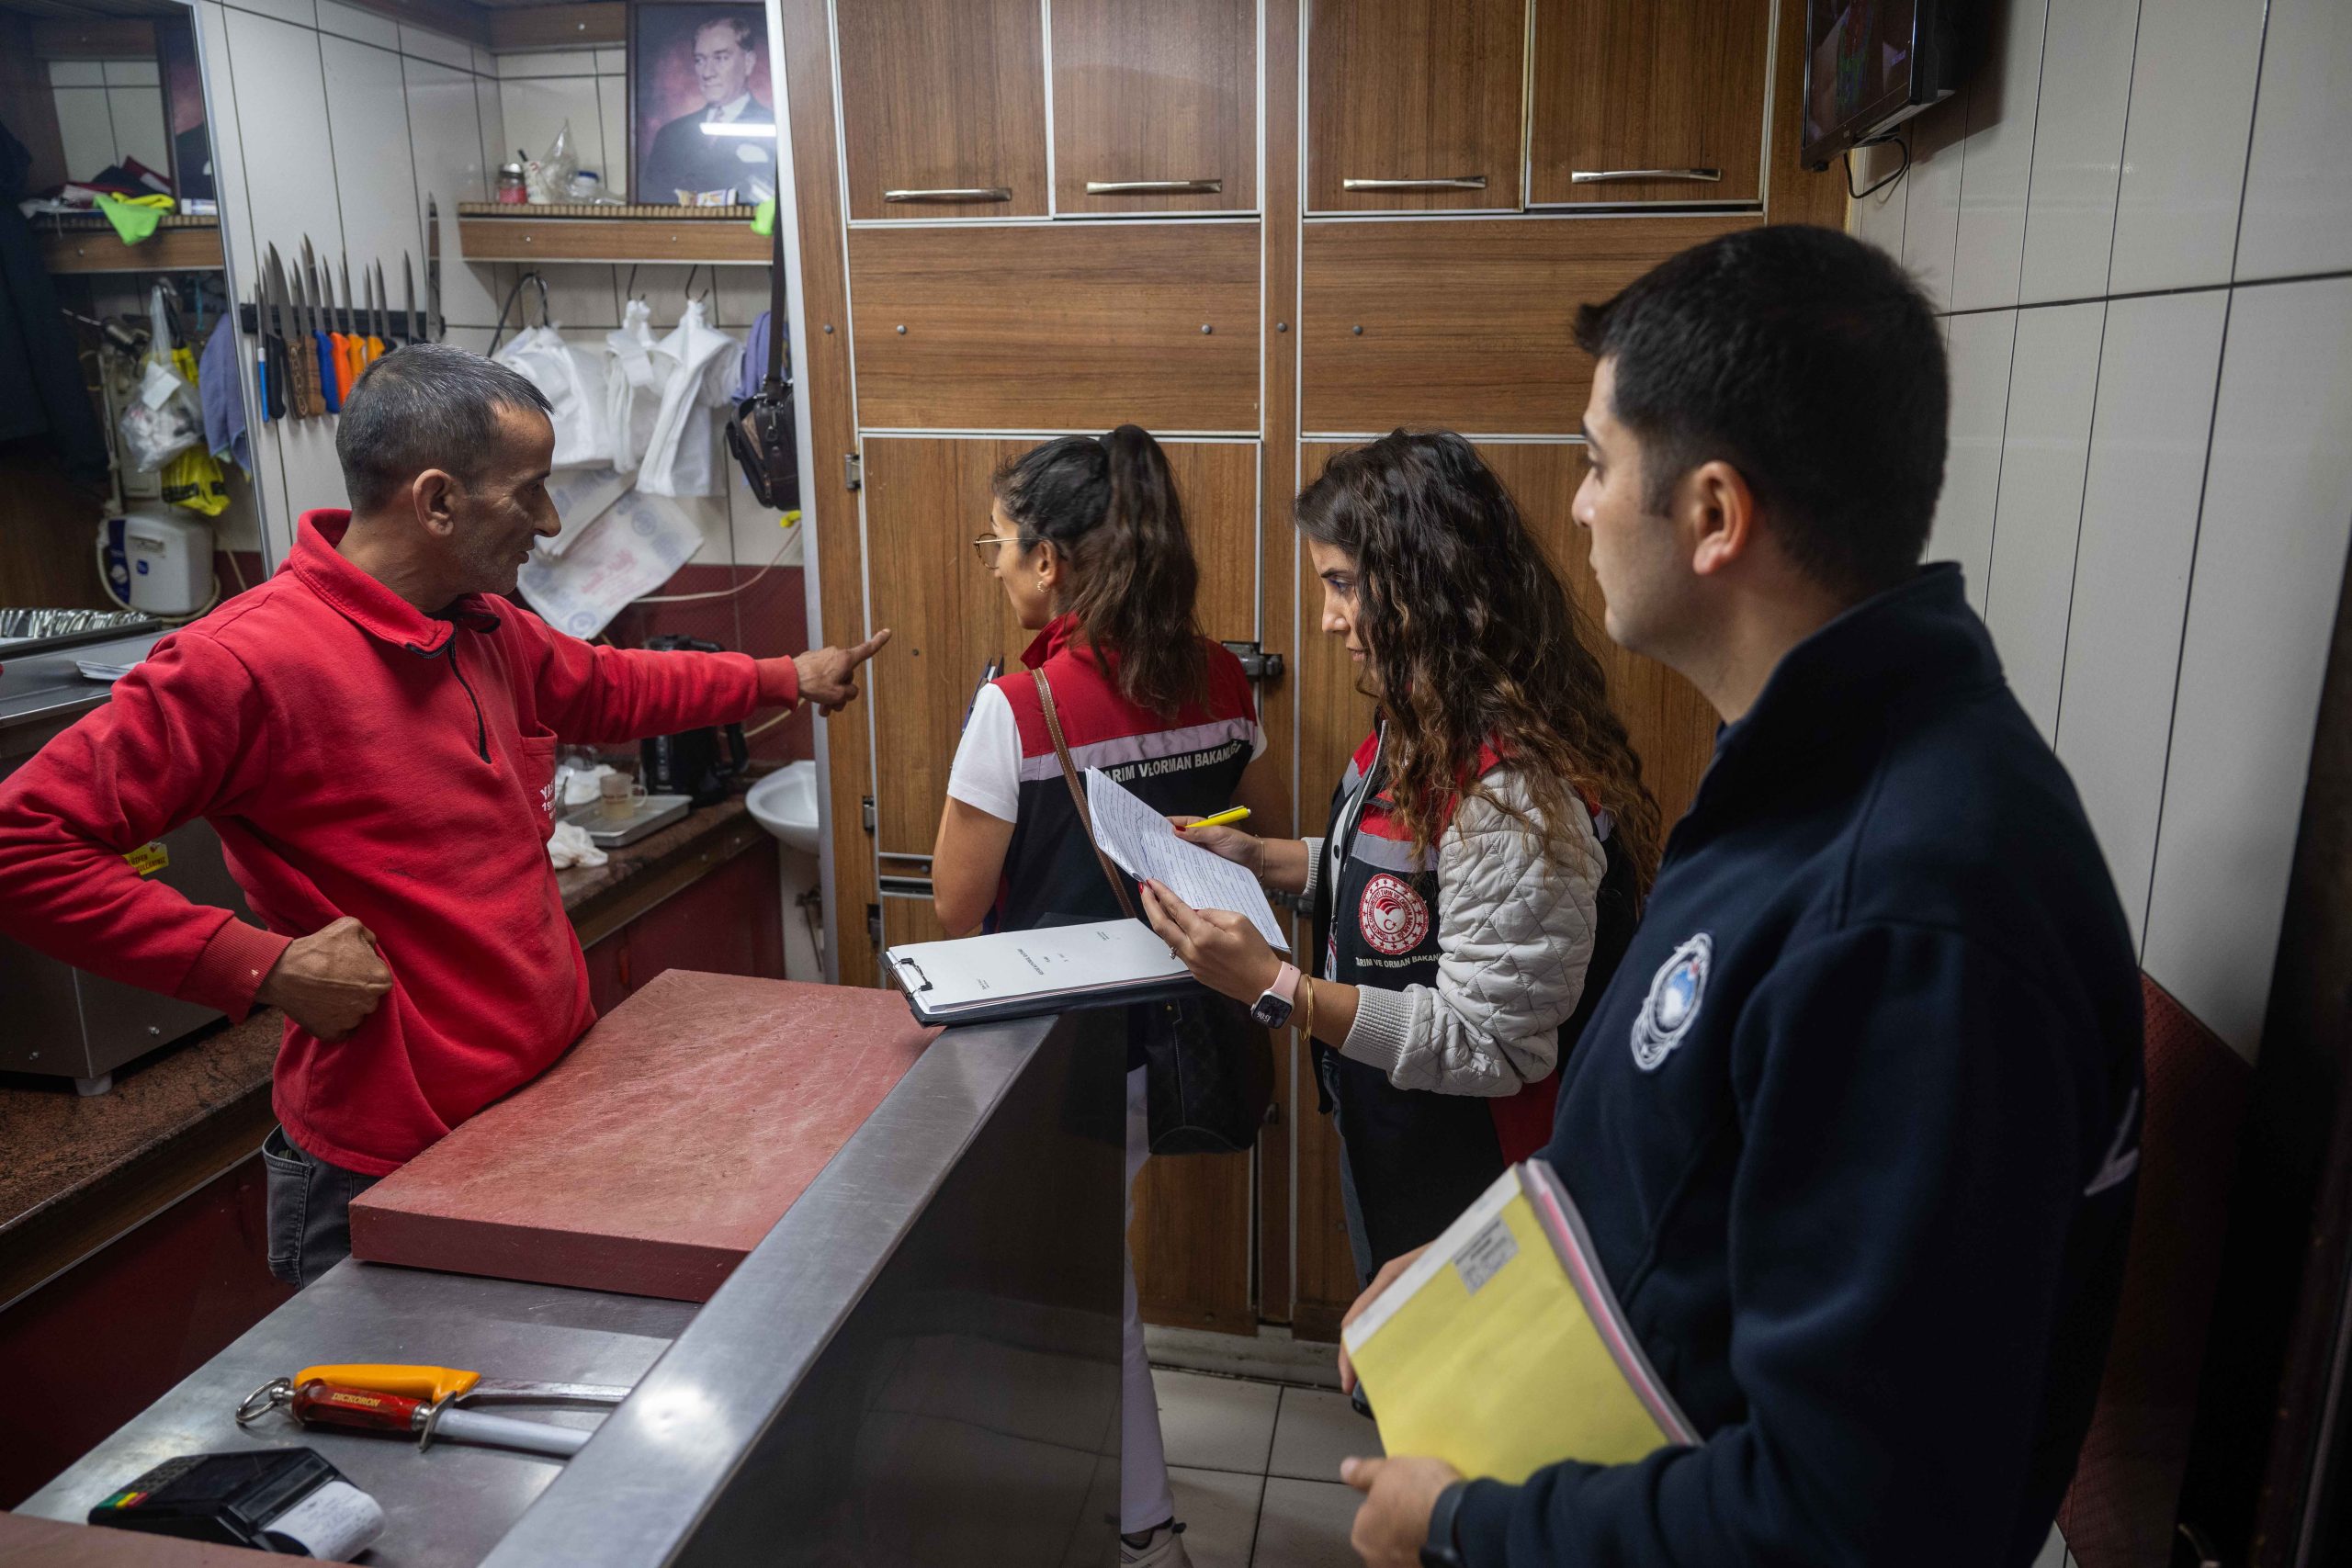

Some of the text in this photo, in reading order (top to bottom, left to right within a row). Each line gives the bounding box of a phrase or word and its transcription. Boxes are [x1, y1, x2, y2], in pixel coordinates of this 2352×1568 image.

[1103, 763, 1136, 783] ARIM
[1152, 754, 1193, 773] ORMAN
[1355, 953, 1442, 968] RIM VE ORMAN BAKAN
